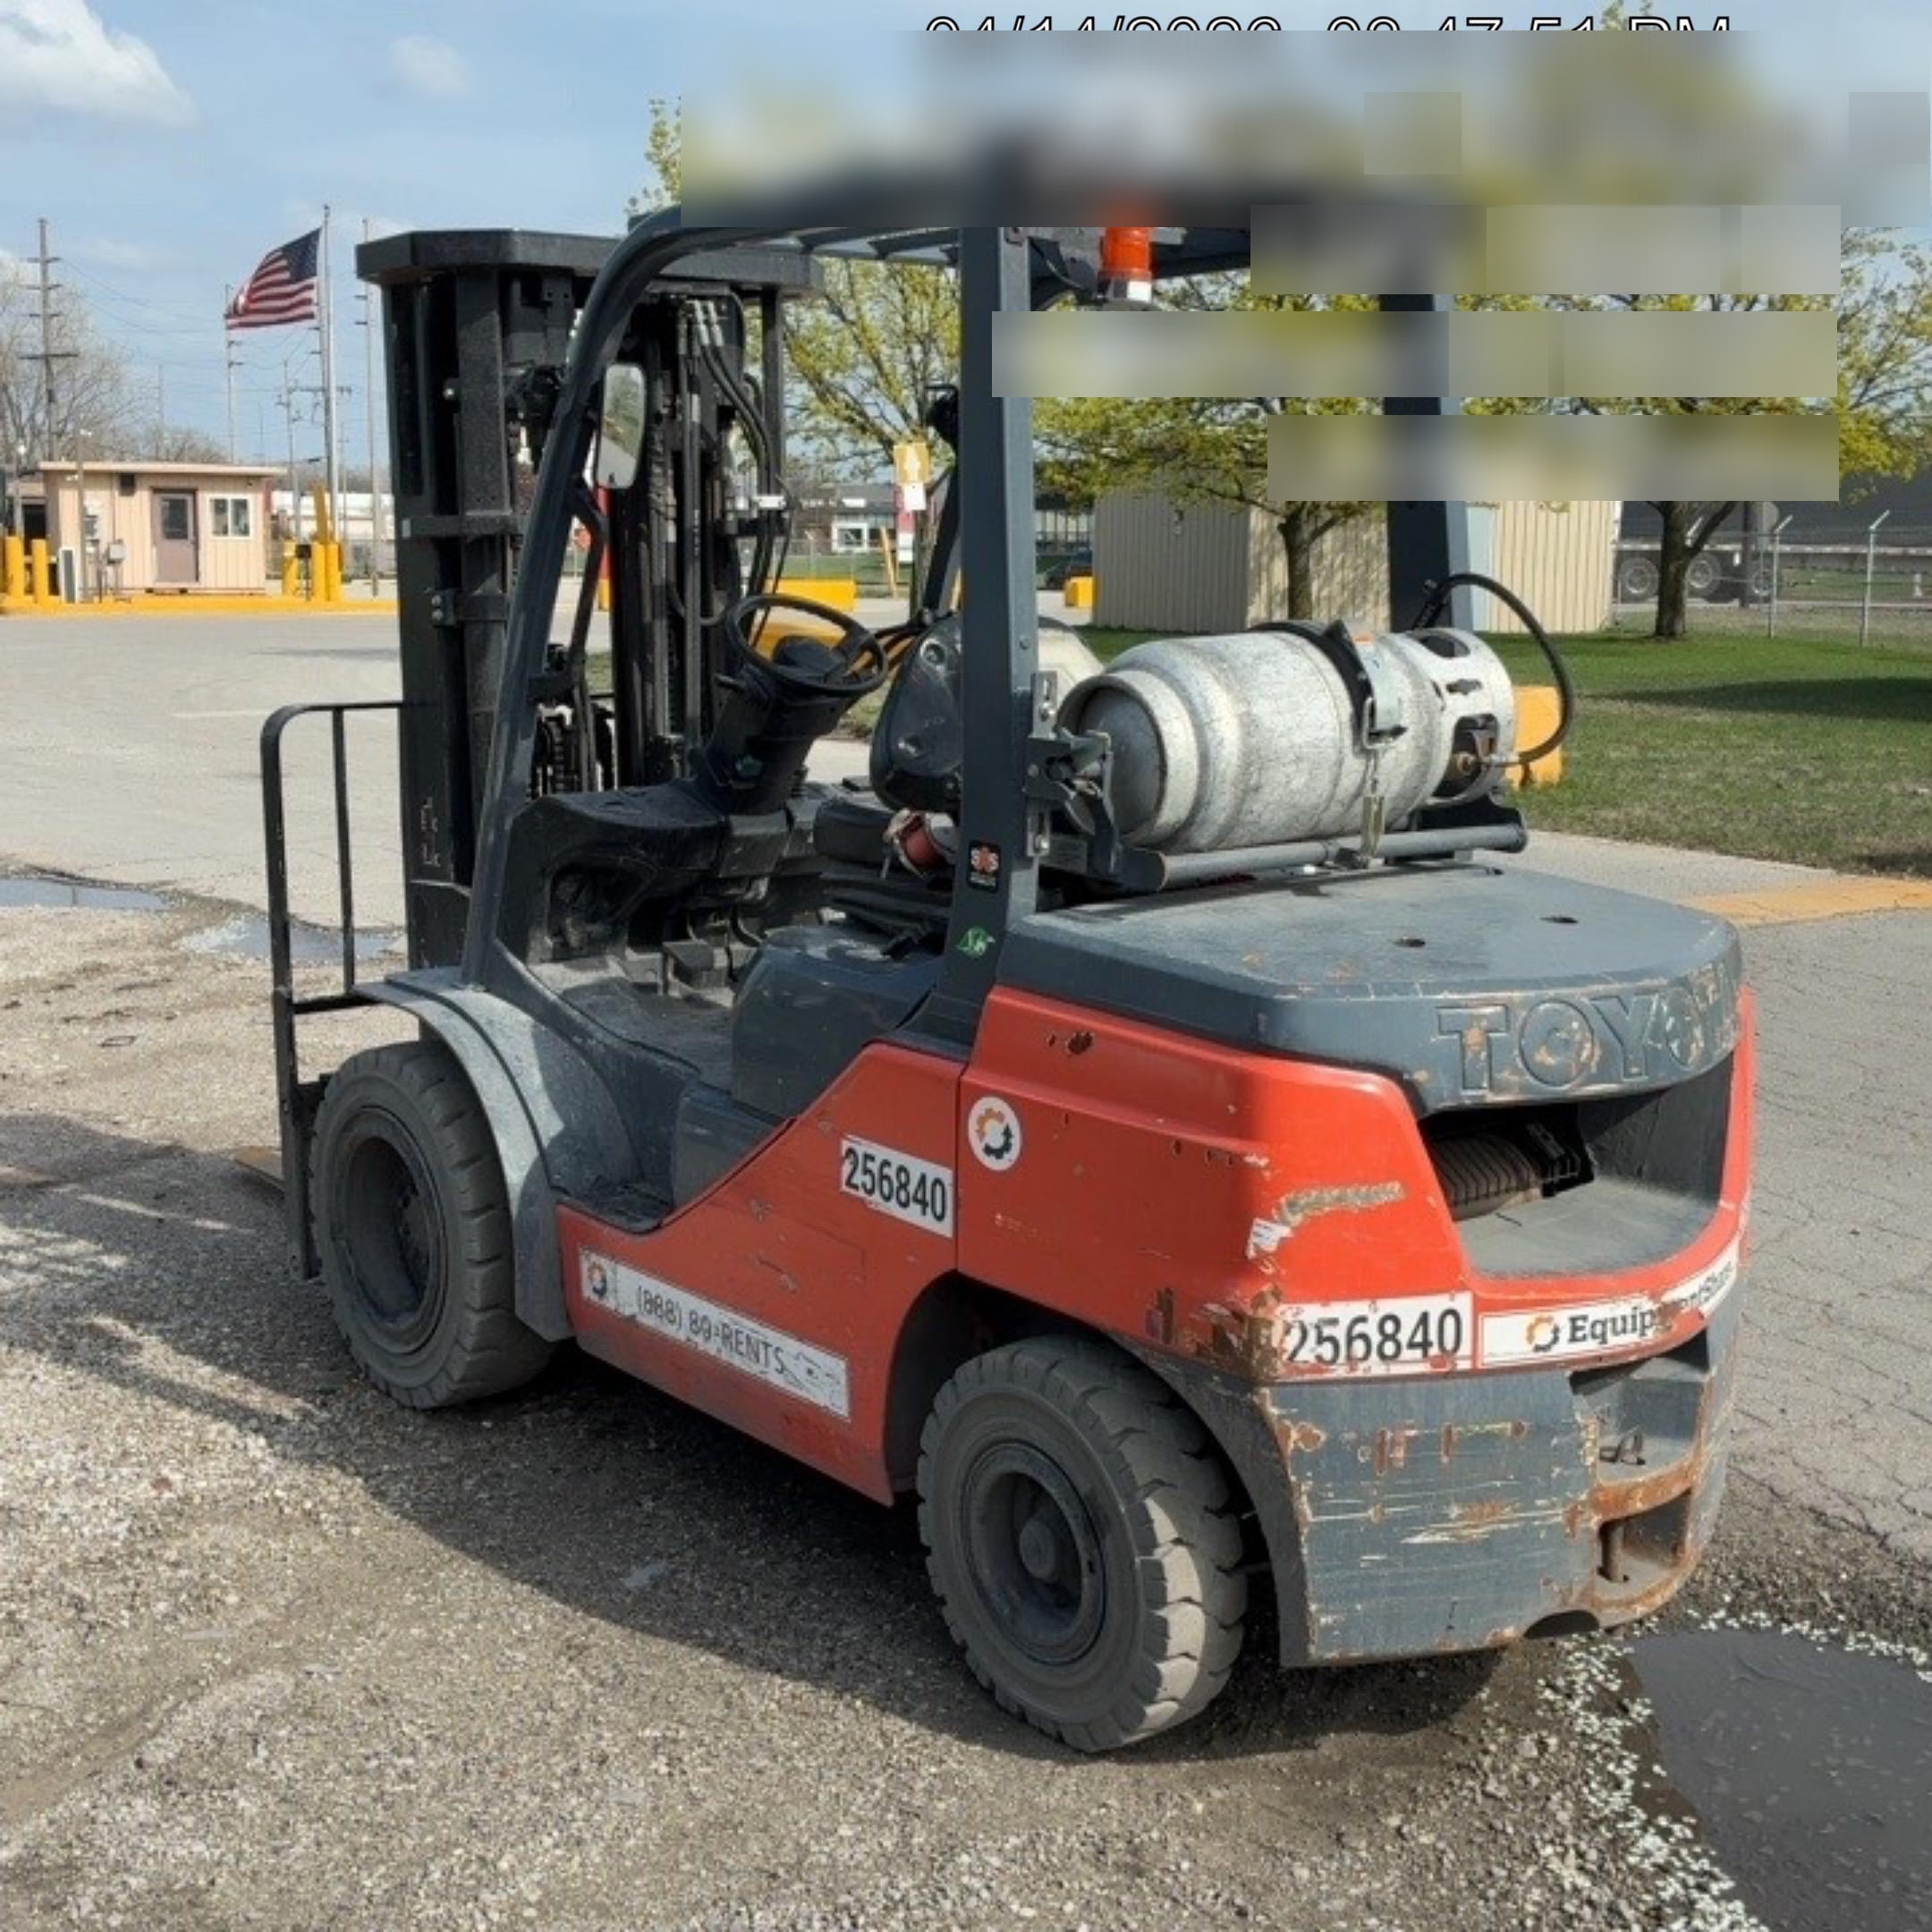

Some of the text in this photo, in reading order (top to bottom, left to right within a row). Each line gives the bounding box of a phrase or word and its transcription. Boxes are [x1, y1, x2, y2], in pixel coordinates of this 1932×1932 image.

[843, 1147, 945, 1223] 256840
[1283, 1309, 1462, 1366] 256840
[1567, 1305, 1664, 1345] Equip
